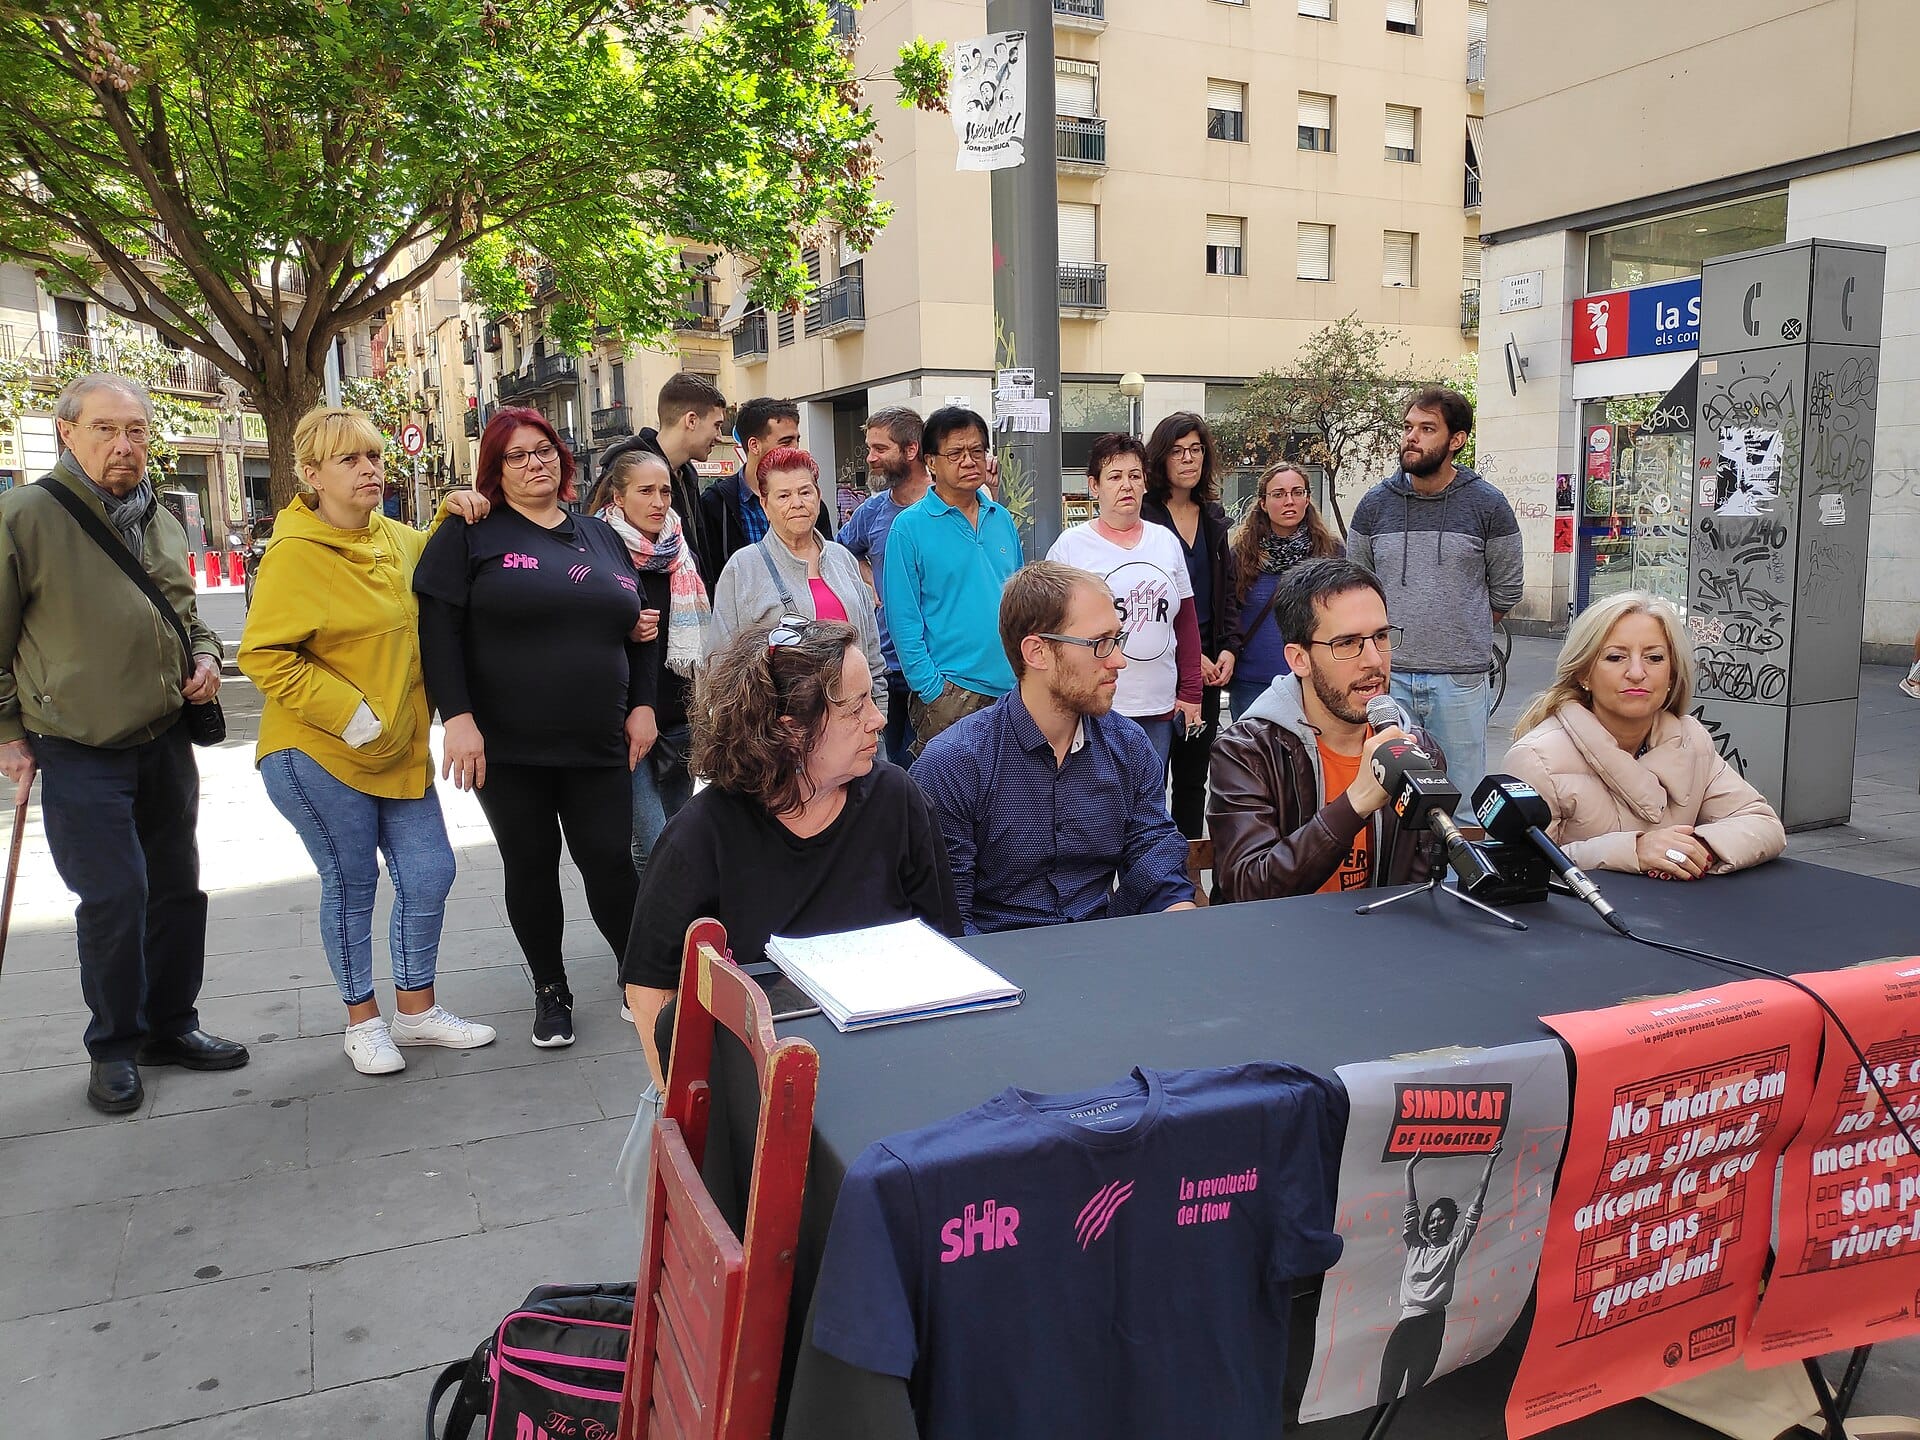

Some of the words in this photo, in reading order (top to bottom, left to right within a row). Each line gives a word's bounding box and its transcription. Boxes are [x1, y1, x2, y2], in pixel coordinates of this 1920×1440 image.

[1656, 301, 1680, 330] la
[1655, 332, 1673, 345] els
[1678, 331, 1699, 343] con
[502, 552, 540, 570] SHR
[1113, 590, 1169, 623] SHR
[1501, 782, 1534, 792] SER
[1476, 789, 1501, 823] SER
[1626, 1027, 1636, 1035] La
[1655, 1020, 1664, 1028] de
[1643, 1035, 1651, 1043] la
[1652, 1029, 1674, 1044] pujada
[1675, 1027, 1687, 1038] que
[1716, 1013, 1743, 1026] Goldman
[1856, 1061, 1900, 1094] Les
[1401, 1089, 1505, 1120] SINDICAT
[1608, 1103, 1650, 1141] No
[1660, 1070, 1786, 1127] marxem
[1834, 1111, 1875, 1135] no
[1880, 1095, 1920, 1126] só
[1397, 1132, 1416, 1146] DE
[1419, 1132, 1493, 1146] LLOGATERS
[1609, 1151, 1652, 1182] en
[1659, 1112, 1762, 1169] silenci,
[1179, 1177, 1195, 1200] La
[1197, 1167, 1258, 1199] revolució
[1574, 1181, 1663, 1232] alcem
[1671, 1167, 1698, 1199] la
[1709, 1150, 1761, 1185] veu
[1841, 1176, 1891, 1216] són
[1177, 1204, 1199, 1226] del
[1201, 1200, 1231, 1224] flow
[940, 1198, 1020, 1263] SHR
[1629, 1222, 1639, 1260] i
[1649, 1213, 1701, 1252] ens
[1592, 1237, 1721, 1319] quedem!
[1691, 1321, 1734, 1345] SINDICAT
[544, 1408, 577, 1436] The
